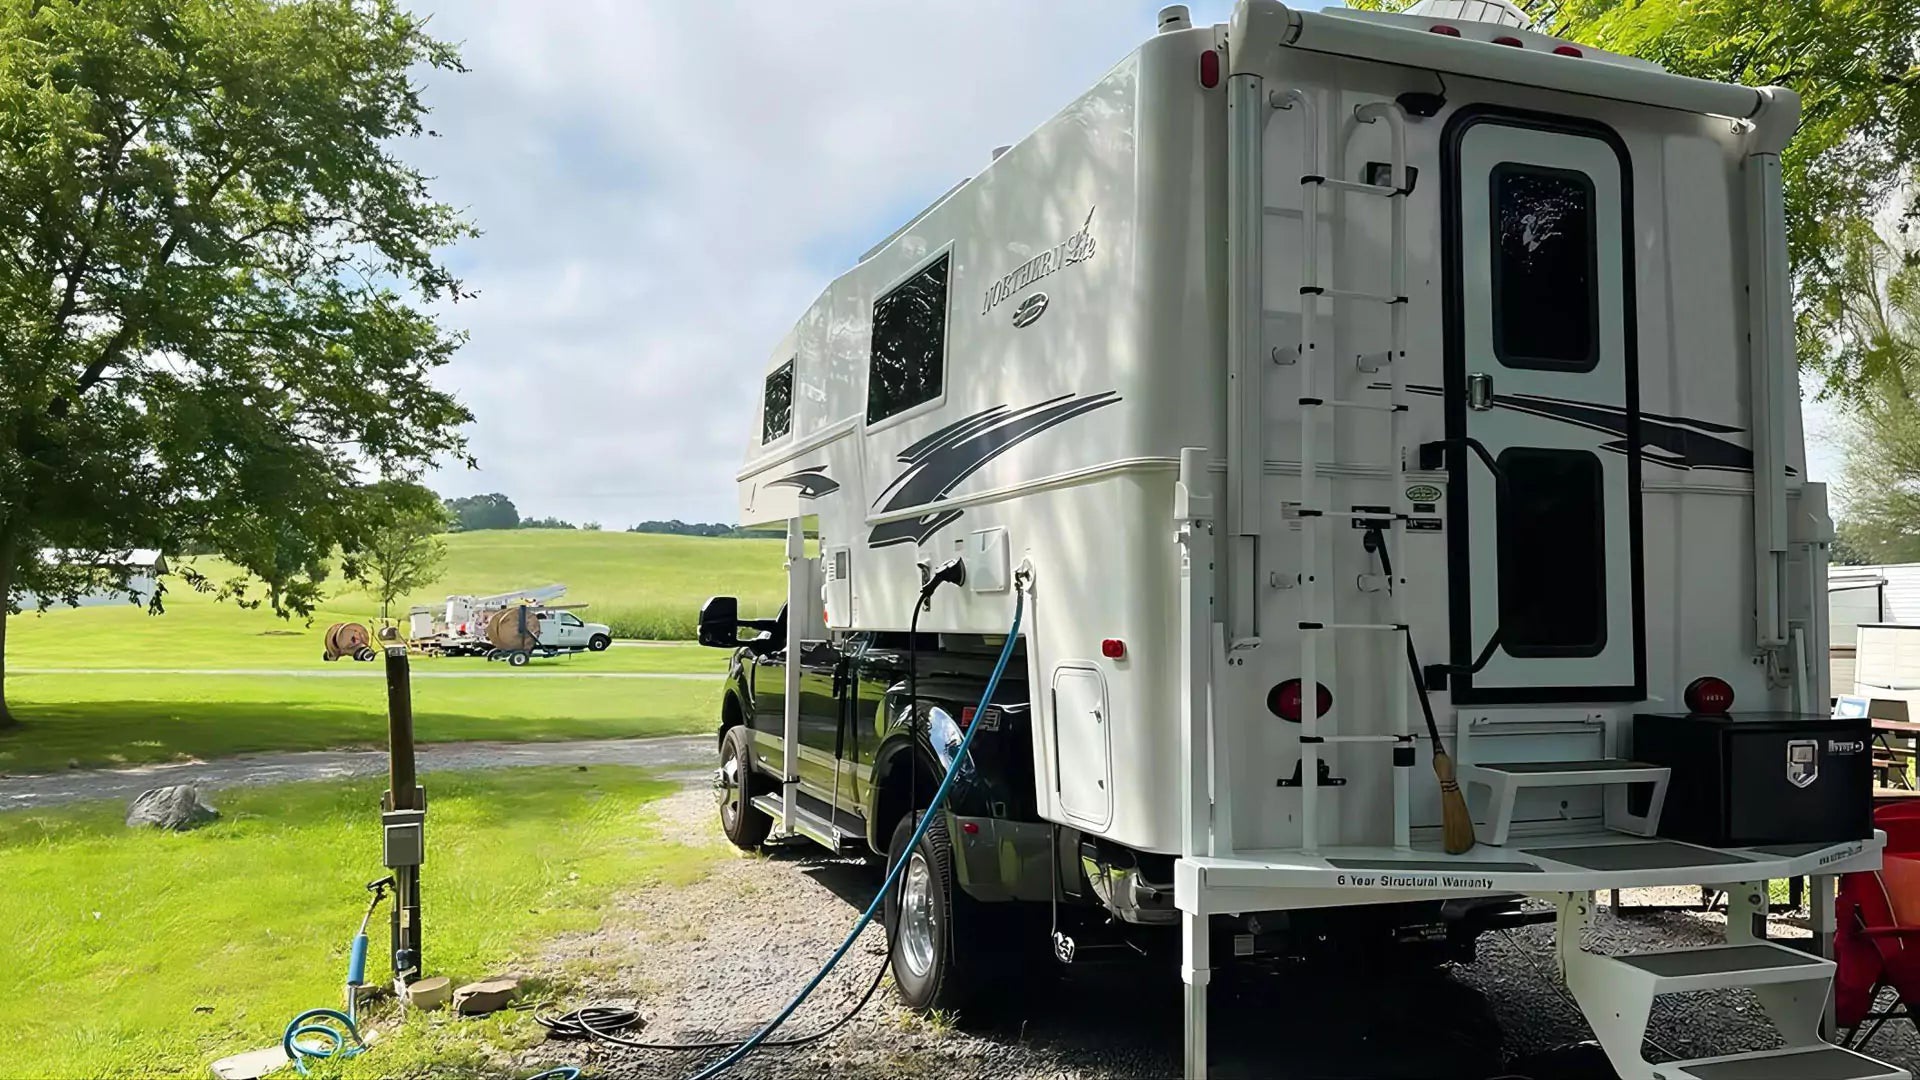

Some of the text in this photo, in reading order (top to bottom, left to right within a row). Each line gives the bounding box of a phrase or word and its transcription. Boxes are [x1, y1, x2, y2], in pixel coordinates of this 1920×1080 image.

[981, 241, 1066, 316] NORTHERN
[1337, 875, 1494, 889] 6 Year Structural Warranty
